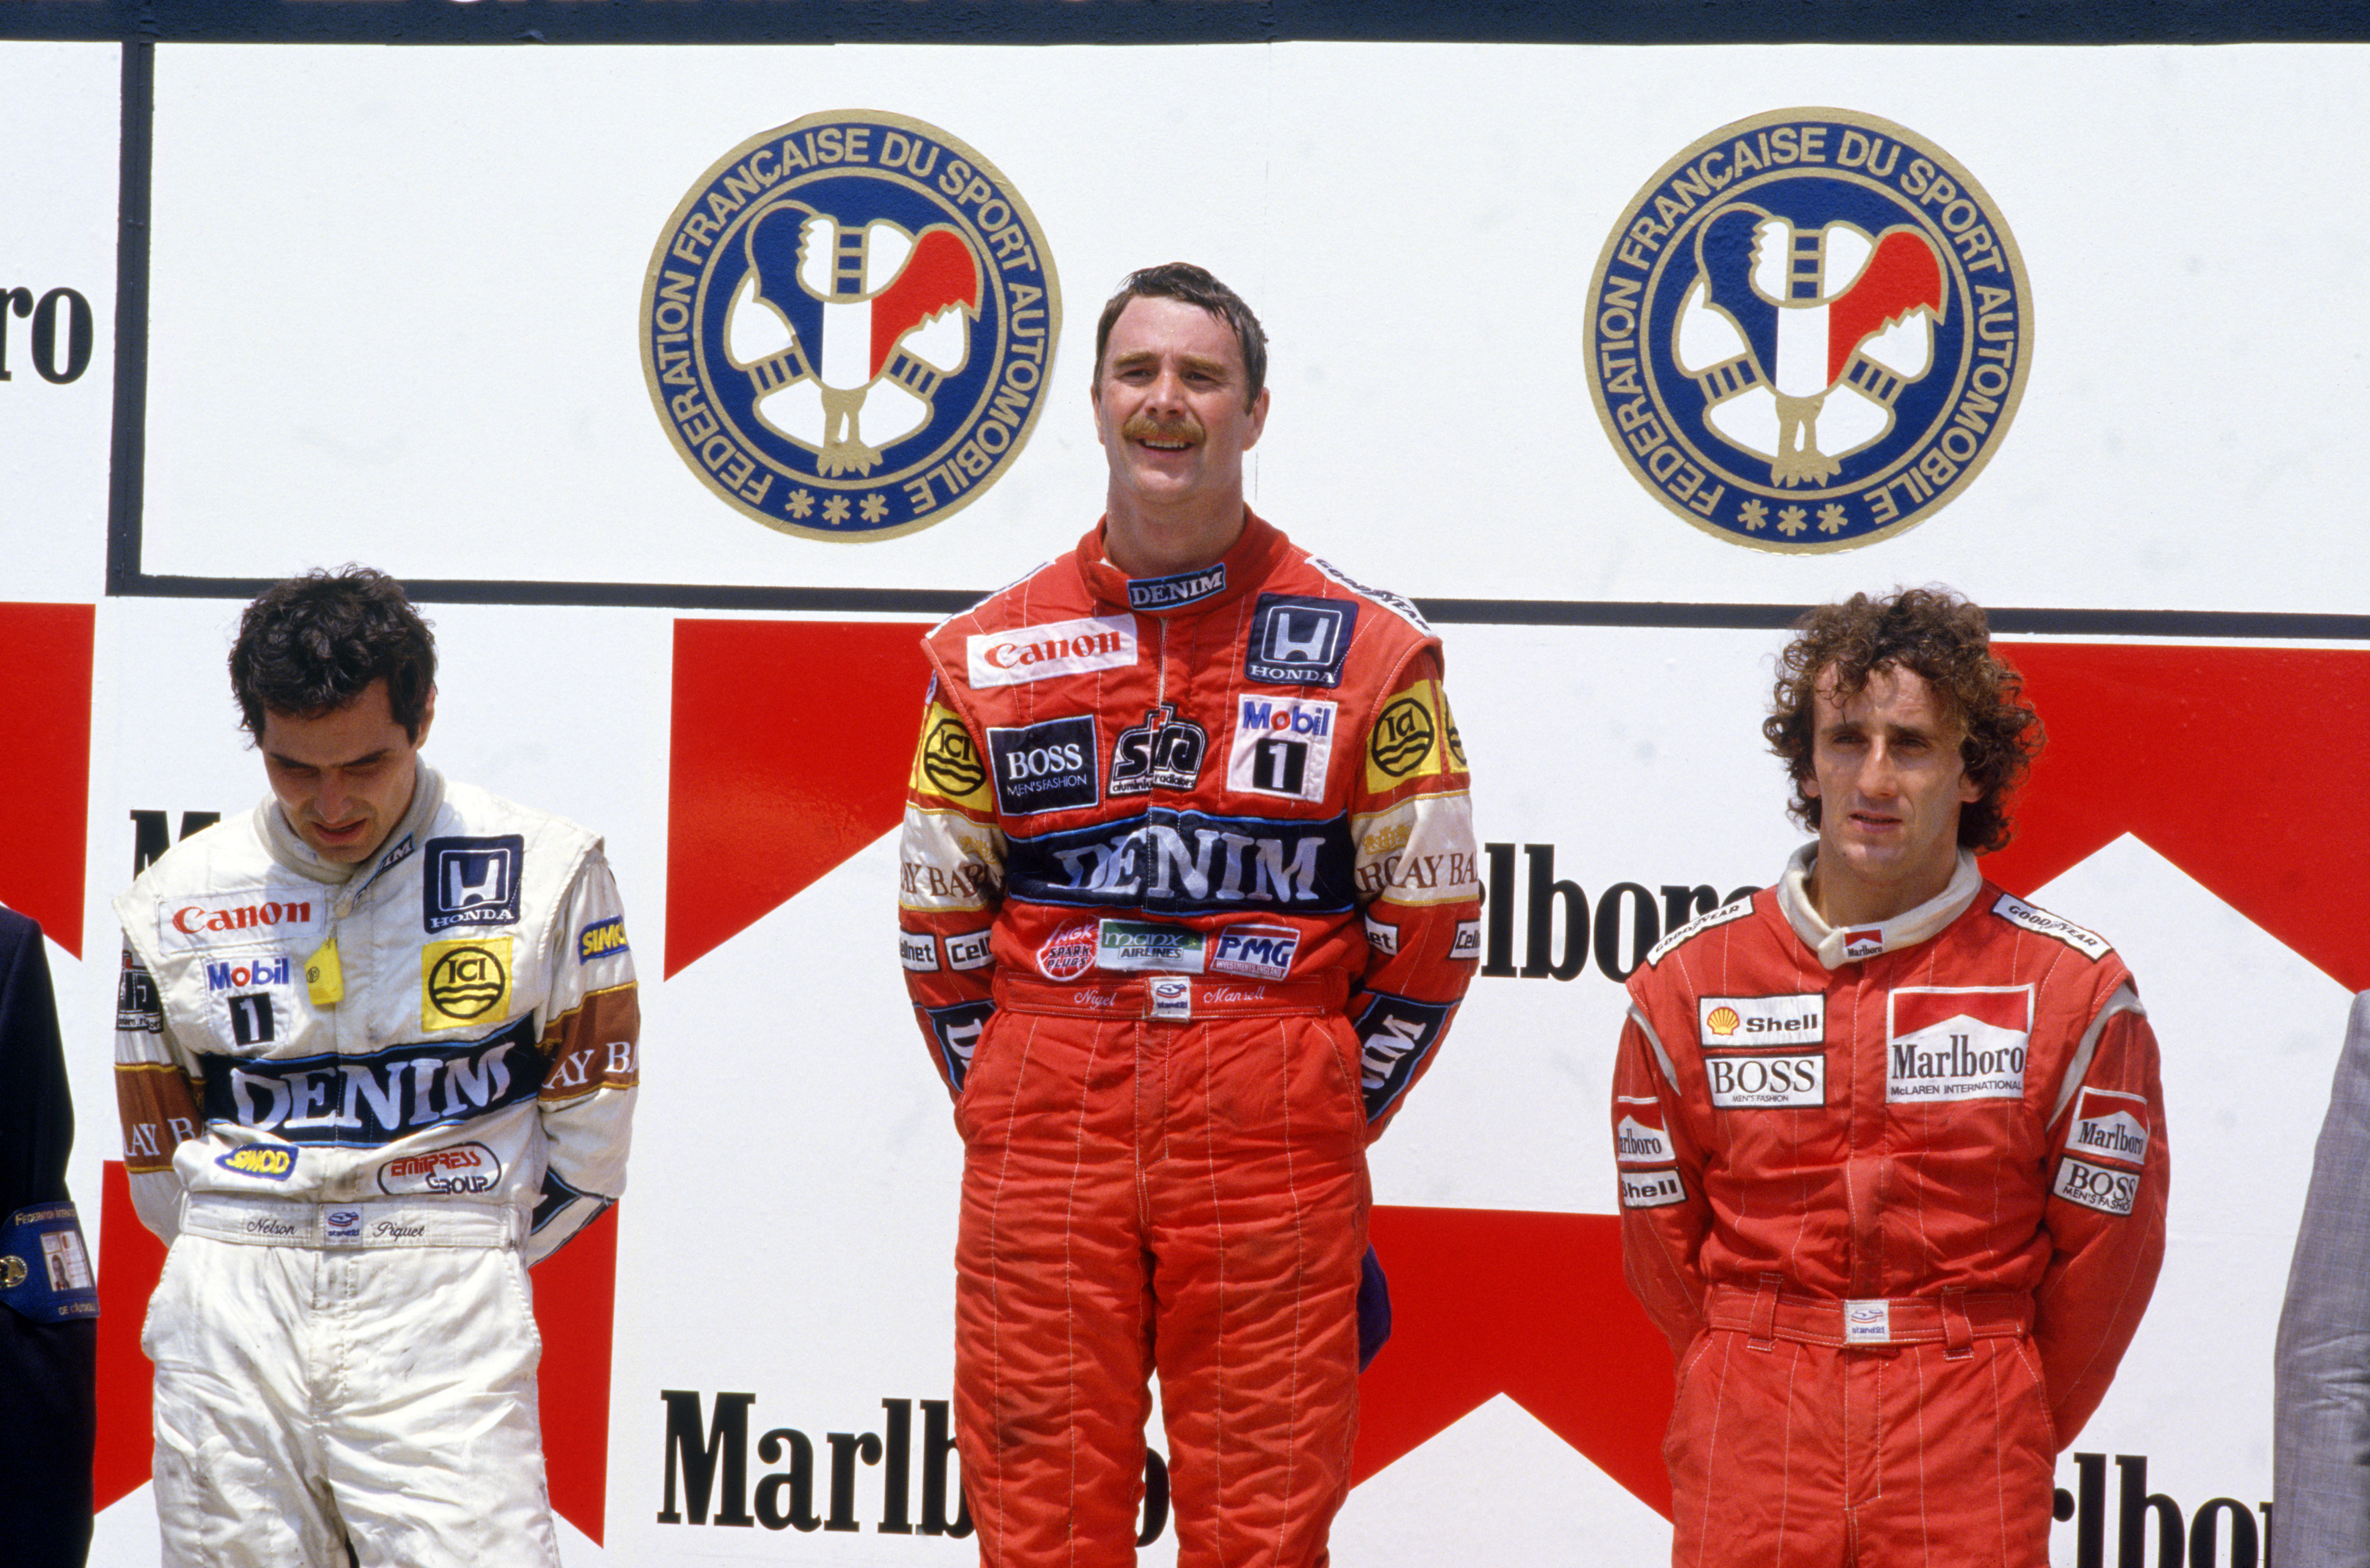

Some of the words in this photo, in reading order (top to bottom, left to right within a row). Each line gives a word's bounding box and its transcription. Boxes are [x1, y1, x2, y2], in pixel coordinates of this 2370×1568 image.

[879, 131, 940, 177] DU
[1837, 130, 1902, 177] DU
[673, 128, 871, 263] FRANÇAISE
[1617, 127, 1827, 270] FRANÇAISE
[939, 160, 1037, 271] SPORT
[1900, 159, 2004, 275] SPORT
[656, 269, 775, 505] FEDERATION
[903, 281, 1045, 514] AUTOMOBILE
[1599, 275, 1726, 517] FEDERATION
[1863, 284, 2014, 525] AUTOMOBILE
[1130, 570, 1224, 605] DENIM
[984, 630, 1125, 671] Canon
[1251, 665, 1336, 684] HONDA
[1243, 701, 1331, 736] Mobil
[938, 728, 971, 761] ICI
[1007, 744, 1083, 779] BOSS
[1269, 743, 1289, 788] 1
[1007, 781, 1042, 797] MEN'S
[1042, 774, 1087, 791] FASHION
[1048, 825, 1326, 902] DENIM
[172, 901, 310, 934] Canon
[430, 909, 515, 929] HONDA
[1055, 924, 1096, 944] NGK
[1049, 946, 1091, 957] SPARK
[1105, 932, 1184, 947] manx
[1120, 946, 1182, 958] AIRLINES
[1216, 936, 1296, 967] PMG
[1847, 943, 1883, 957] Marlboro
[206, 957, 289, 991] Mobil
[446, 957, 487, 984] ICI
[1047, 956, 1089, 968] PLUGS
[1074, 989, 1117, 1008] Nigel
[1204, 985, 1264, 1003] Mansell
[239, 998, 260, 1041] 1
[1746, 1014, 1818, 1033] Shell
[1892, 1035, 2024, 1079] Marlboro
[231, 1042, 515, 1132] DENIM
[1711, 1060, 1815, 1094] BOSS
[1890, 1084, 1939, 1096] McLAREN
[1944, 1080, 2022, 1095] INTERNATIONAL
[1757, 1094, 1789, 1102] FASHION
[2078, 1121, 2144, 1155] Marlboro
[226, 1150, 290, 1174] SIMOD
[391, 1150, 481, 1177] EMPRESS
[425, 1173, 489, 1194] GROUP
[2063, 1186, 2096, 1204] MEN'S
[2067, 1163, 2136, 1203] BOSS
[247, 1218, 297, 1236] Nelson
[373, 1221, 425, 1242] Piquet
